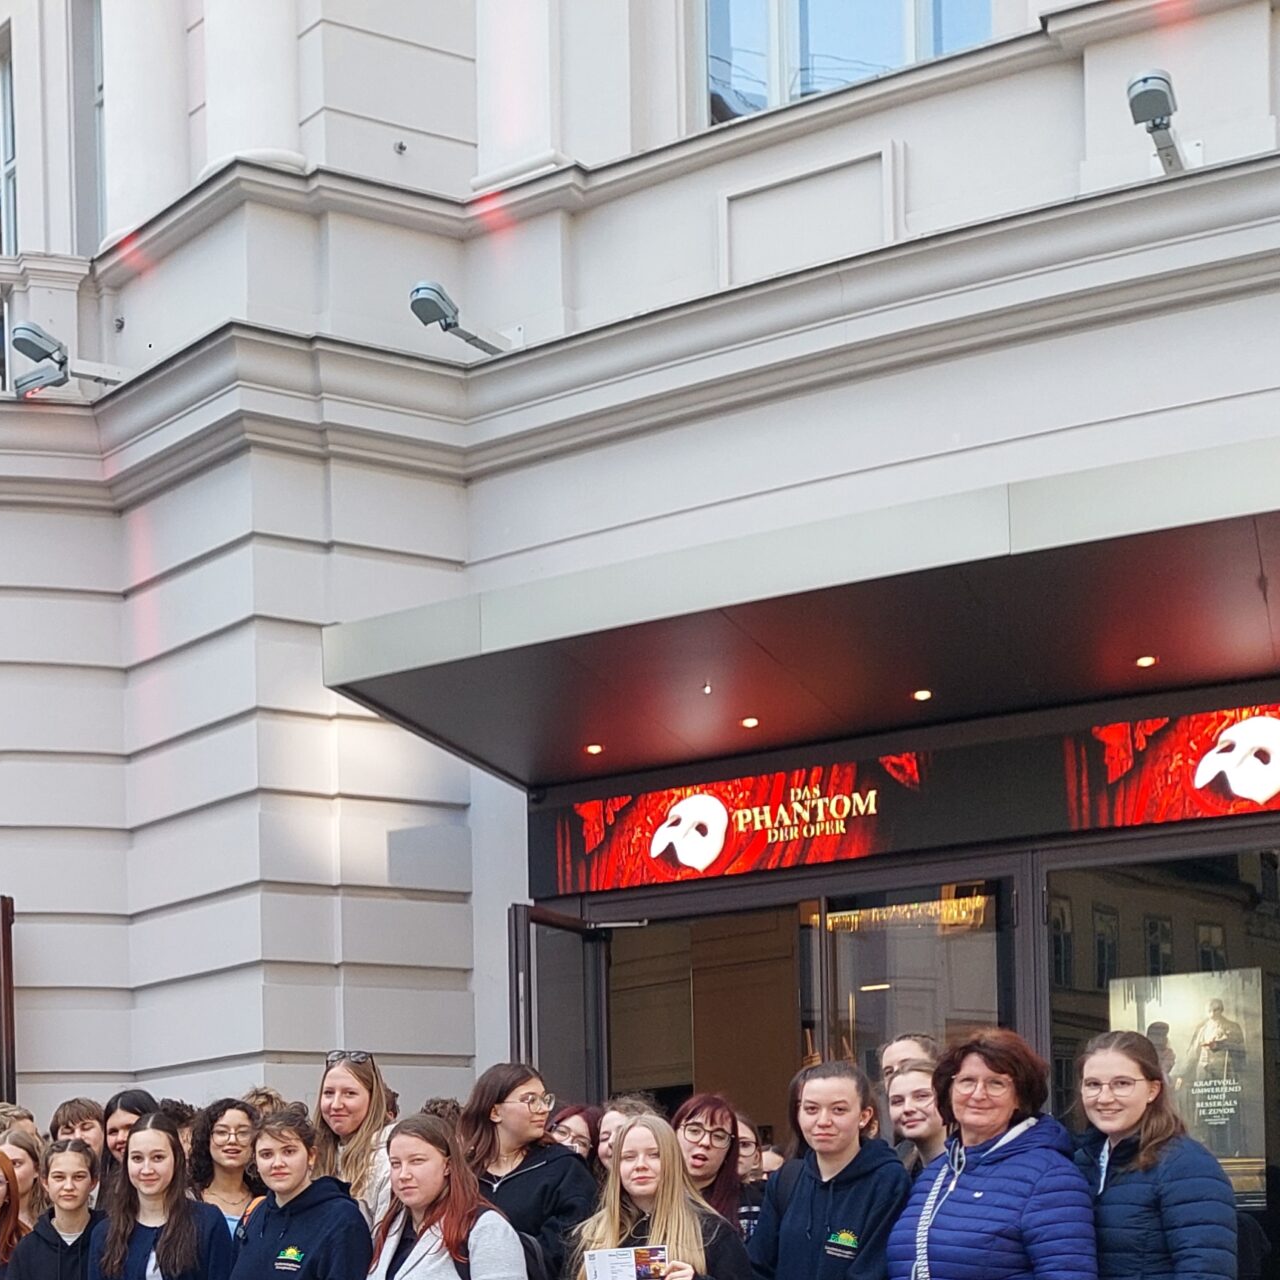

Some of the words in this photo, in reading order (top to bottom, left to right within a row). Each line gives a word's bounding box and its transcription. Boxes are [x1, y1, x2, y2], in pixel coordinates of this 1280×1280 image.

[790, 784, 821, 802] DAS
[732, 790, 877, 833] PHANTOM
[767, 826, 799, 843] DER
[802, 819, 846, 839] OPER
[1223, 1099, 1238, 1107] ALS
